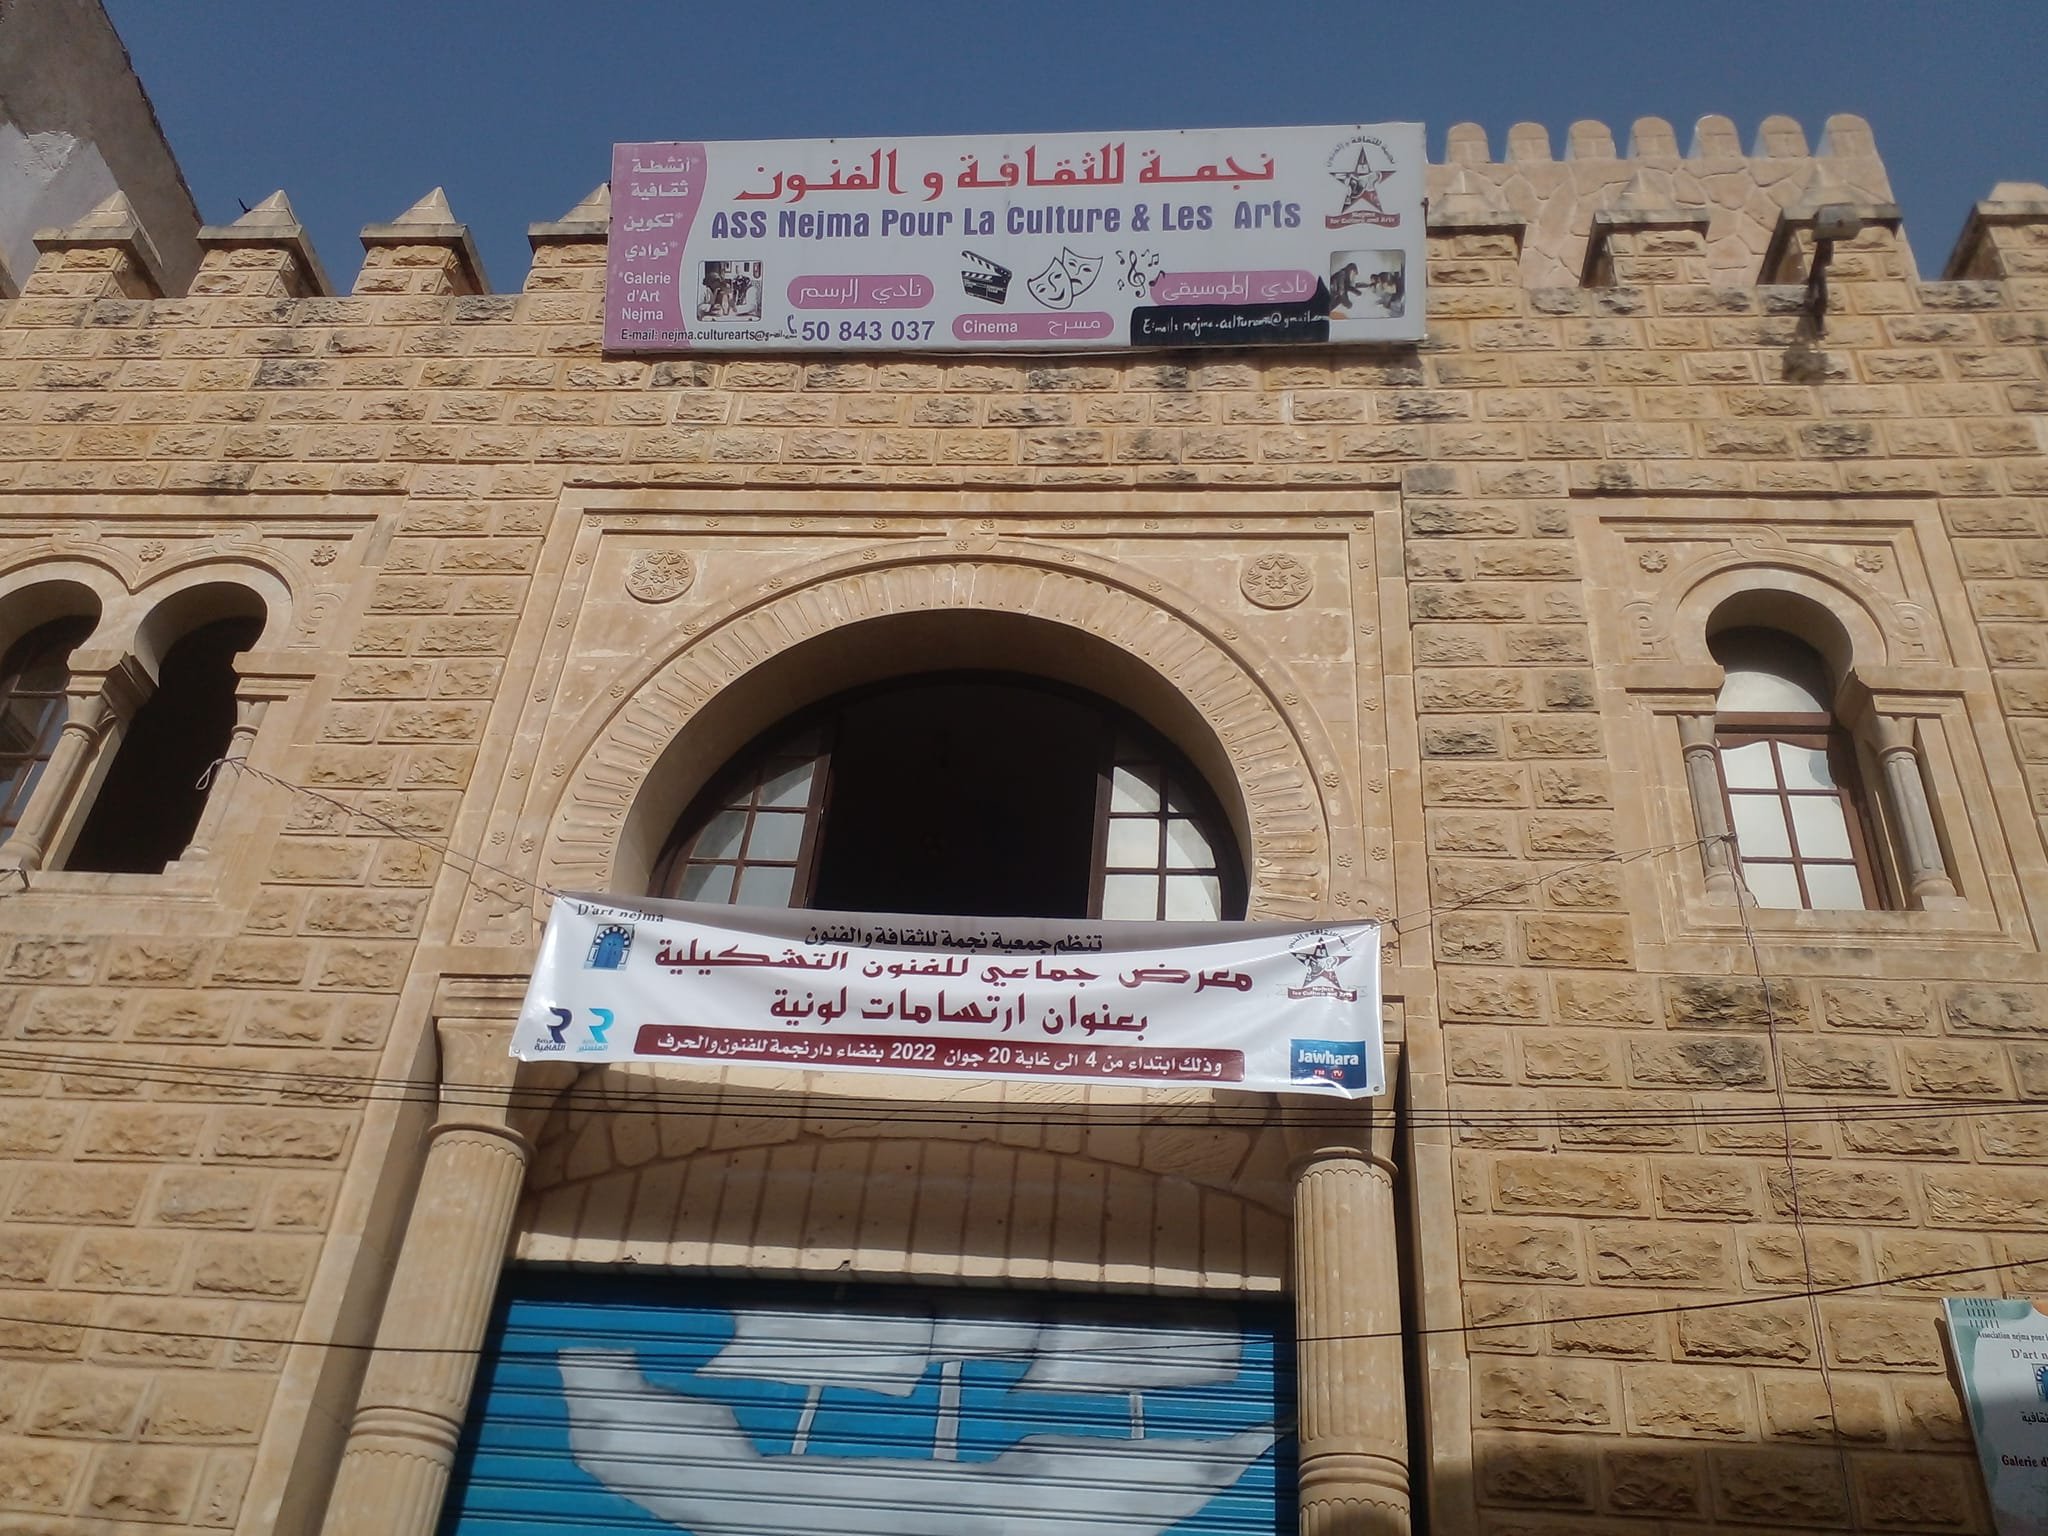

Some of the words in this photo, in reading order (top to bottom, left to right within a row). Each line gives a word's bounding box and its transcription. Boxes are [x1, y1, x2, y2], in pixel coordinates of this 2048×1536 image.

[957, 142, 1125, 188] للثقافة
[1139, 149, 1274, 190] نجمة
[732, 148, 908, 203] الفنون
[631, 180, 689, 200] ثقافية
[922, 171, 944, 202] و
[623, 213, 675, 232] تكوين
[711, 210, 768, 239] ASS
[778, 210, 870, 241] Nejma
[881, 208, 953, 237] Pour
[963, 207, 996, 236] La
[1006, 204, 1121, 236] Culture
[1130, 203, 1150, 232] &
[1161, 202, 1213, 232] Les
[1234, 199, 1301, 230] Arts
[624, 242, 669, 262] نوادي
[623, 271, 672, 286] Galerie
[1162, 274, 1250, 301] الموسيقى
[1260, 273, 1308, 301] نادي
[626, 289, 661, 304] d'Art
[800, 278, 859, 305] الرسم
[872, 278, 922, 305] نادي
[621, 307, 665, 323] Nejma
[621, 328, 659, 341] E-mail:
[801, 321, 831, 342] 50
[838, 320, 883, 342] 843
[890, 319, 936, 341] 037
[962, 319, 1019, 334] Cinema
[1047, 319, 1101, 337] مسرح
[576, 903, 615, 917] D'art
[619, 909, 665, 923] nejma
[874, 926, 938, 948] للثقافة
[941, 929, 988, 950] نجمة
[991, 931, 1053, 952] جمعية
[1053, 933, 1103, 955] تنظم
[655, 937, 849, 977] التشكيلية
[862, 955, 969, 979] للفنون
[981, 959, 1101, 988] جماعي
[1118, 963, 1254, 994] معرض
[770, 985, 848, 1026] لونية
[861, 986, 1026, 1033] ارتسامات
[1042, 994, 1148, 1042] بعنوان
[722, 1038, 769, 1056] للفنون
[769, 1039, 809, 1058] نجمة
[808, 1043, 832, 1059] دار
[836, 1042, 885, 1062] بفضاء
[889, 1043, 936, 1061] 2022
[988, 1047, 1011, 1065] 20
[943, 1049, 984, 1068] جوان
[1014, 1048, 1051, 1067] غاية
[1085, 1050, 1098, 1068] 4
[1102, 1055, 1124, 1074] من
[1128, 1053, 1176, 1076] ابتداء
[1178, 1053, 1223, 1078] وذلك
[1298, 1049, 1359, 1066] Jawhara
[2010, 1348, 2039, 1360] D'art
[2001, 1455, 2038, 1468] Galerie
